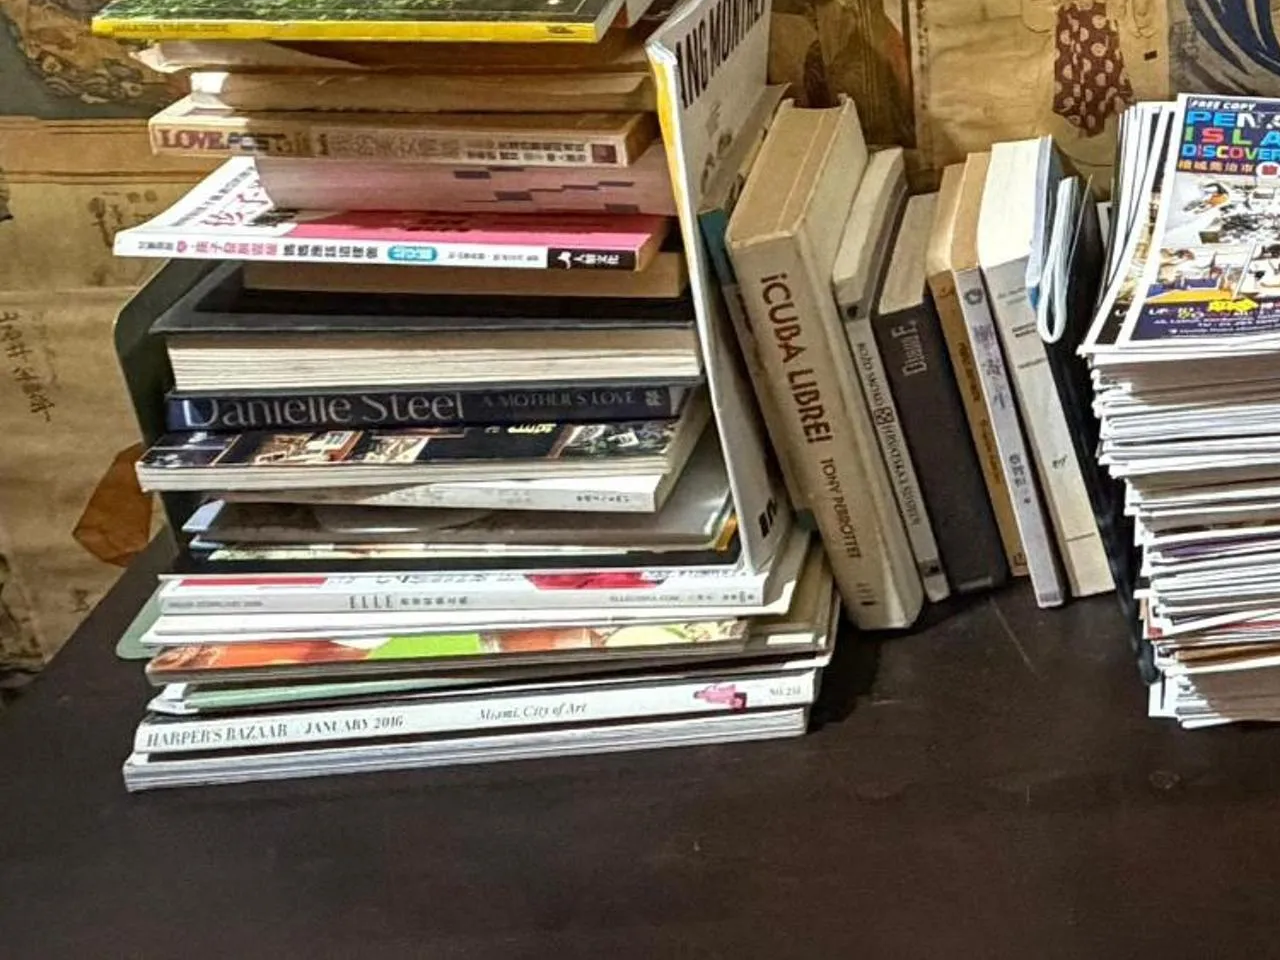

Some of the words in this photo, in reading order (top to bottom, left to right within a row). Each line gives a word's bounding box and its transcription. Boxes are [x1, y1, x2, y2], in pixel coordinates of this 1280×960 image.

[1223, 101, 1257, 111] COPY
[182, 395, 352, 428] Danielle
[361, 391, 465, 424] Steel
[591, 390, 637, 405] LOVE
[786, 367, 833, 444] LIBRE!
[819, 456, 843, 494] TONY
[348, 594, 394, 610] ELLE
[523, 703, 549, 720] City
[552, 701, 566, 717] of
[567, 700, 588, 716] Art
[146, 729, 222, 748] HARPER'S
[225, 723, 288, 742] BAZAAR
[303, 717, 369, 735] JANUARY
